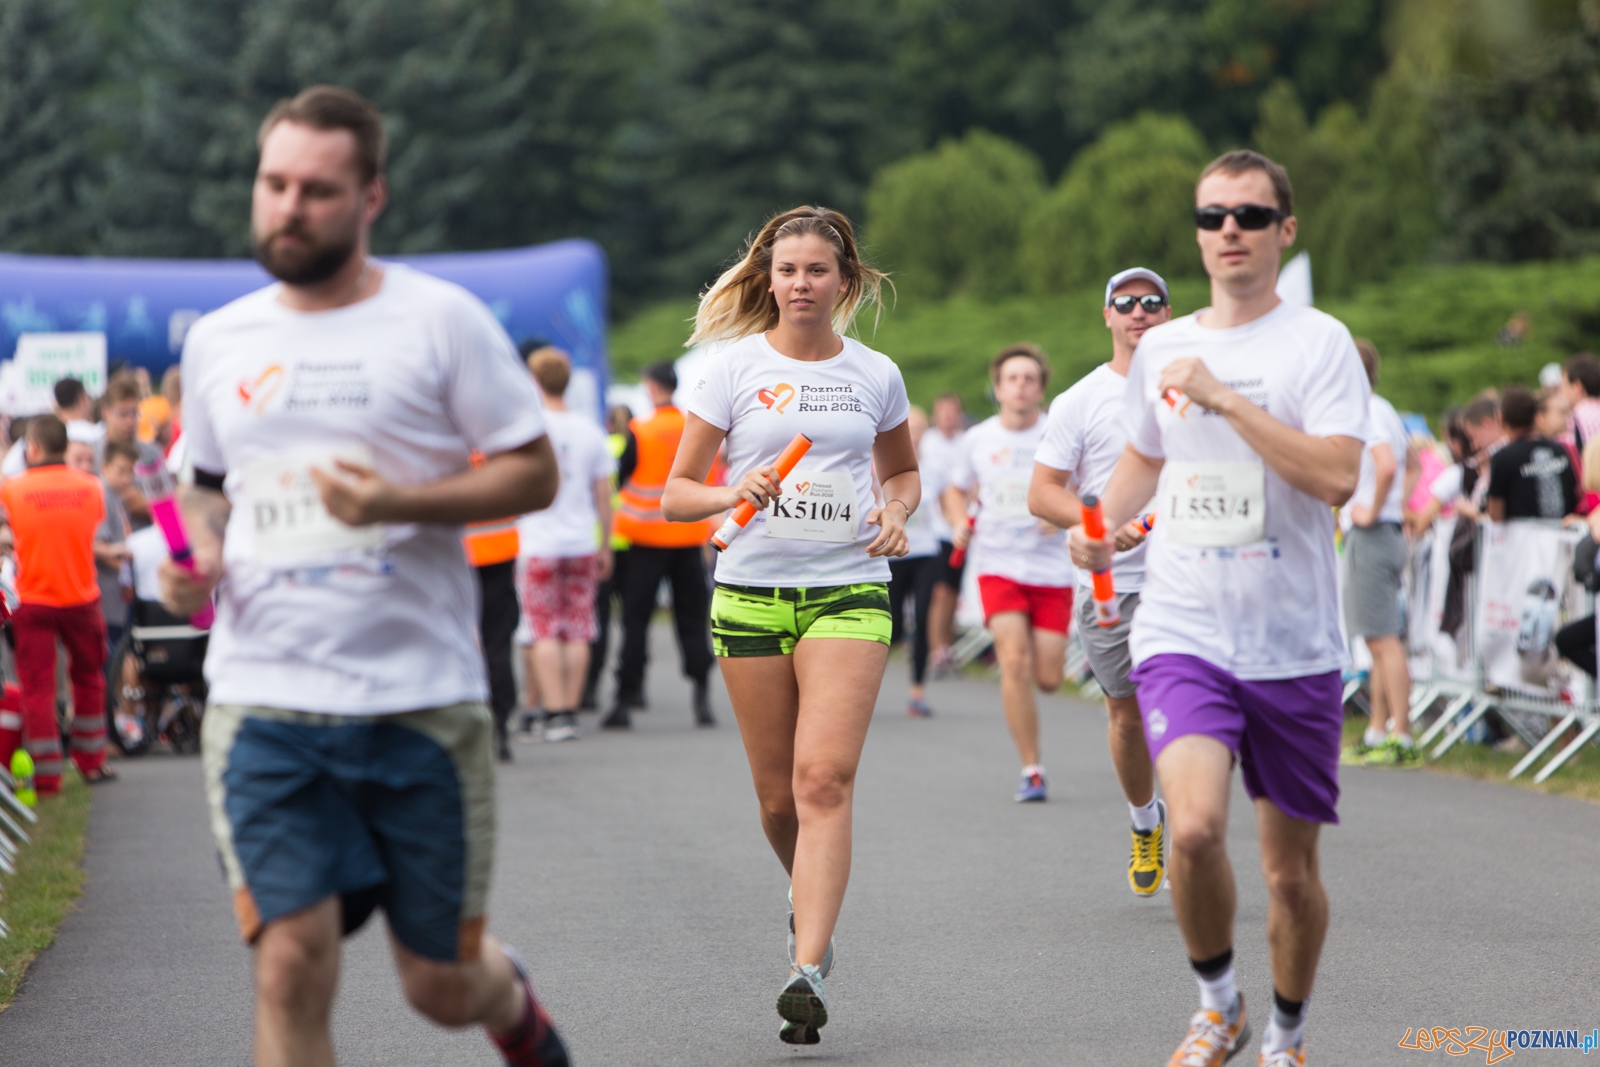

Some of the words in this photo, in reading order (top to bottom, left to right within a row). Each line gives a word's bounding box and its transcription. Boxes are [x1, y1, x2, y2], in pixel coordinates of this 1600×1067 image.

[800, 384, 853, 393] Poznań
[800, 393, 860, 403] Business
[798, 402, 828, 412] Run
[831, 402, 862, 412] 2016
[772, 497, 851, 522] K510/4
